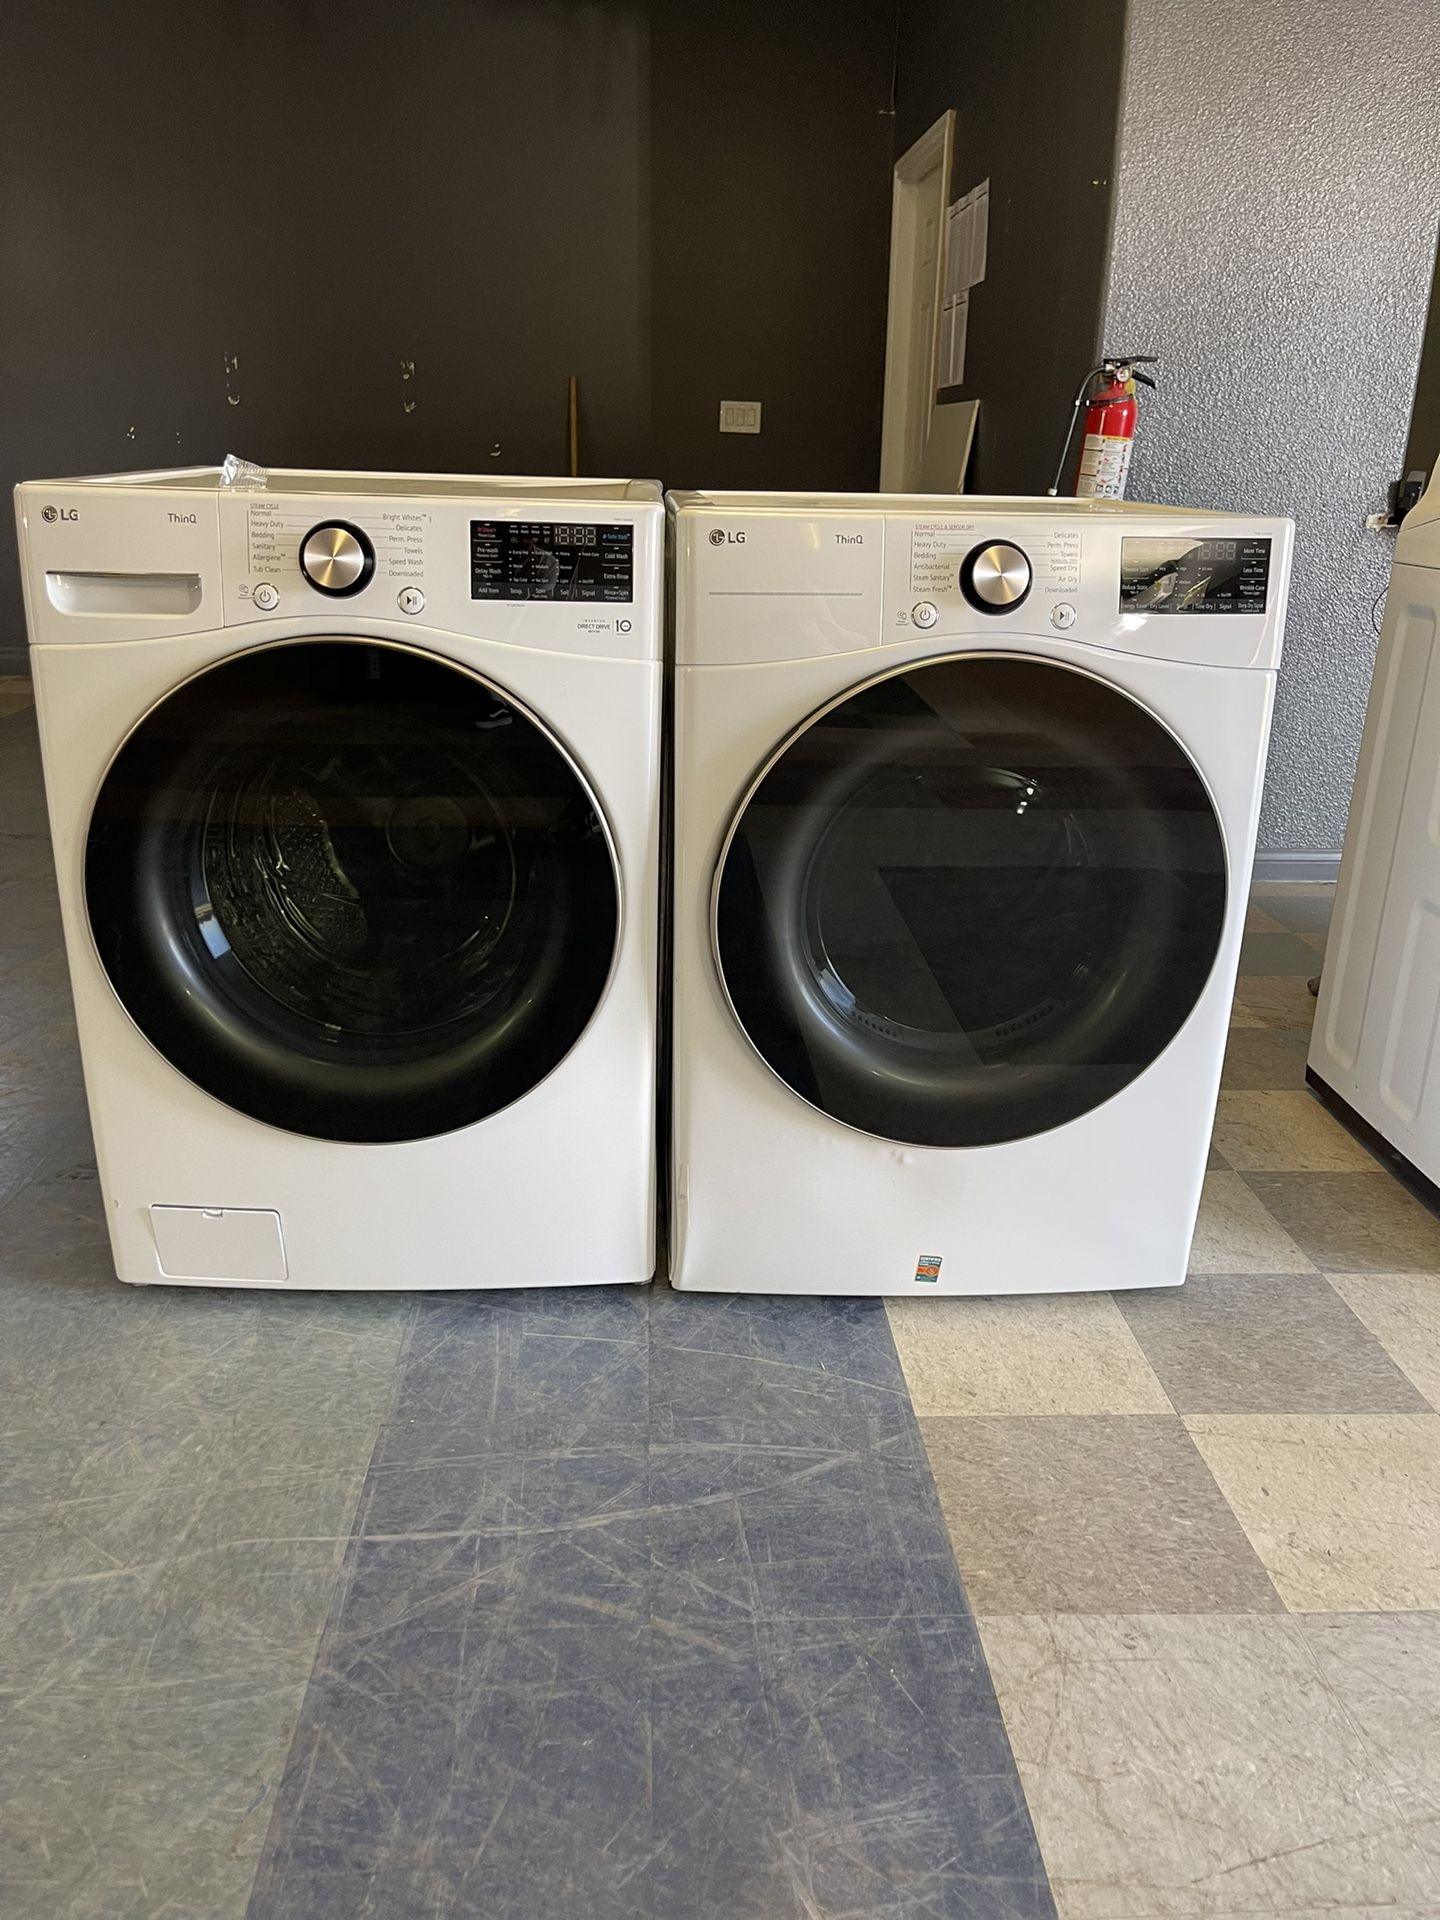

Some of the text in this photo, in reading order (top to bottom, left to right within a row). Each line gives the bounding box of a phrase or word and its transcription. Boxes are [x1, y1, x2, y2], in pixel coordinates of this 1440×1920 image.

[61, 509, 79, 521] LG
[168, 512, 197, 524] ThinQ
[382, 513, 401, 522] Bright
[251, 520, 284, 529] Heavy Duty
[251, 531, 275, 540] Bedding
[407, 535, 423, 543] Press
[728, 532, 746, 543] LG
[835, 534, 864, 544] ThinQ
[252, 542, 276, 551] Sanitary
[914, 541, 947, 549] Heavy Duty
[404, 546, 423, 554] Towels
[1061, 550, 1079, 558] Towels
[913, 551, 937, 560] Bedding
[389, 557, 424, 566] Speed Wash
[914, 562, 950, 570] Antibacterial
[253, 565, 263, 573] Tub
[1050, 564, 1078, 573] Speed Dry
[913, 573, 930, 581] Steam
[1067, 576, 1078, 584] Dry
[913, 585, 931, 593] Steam
